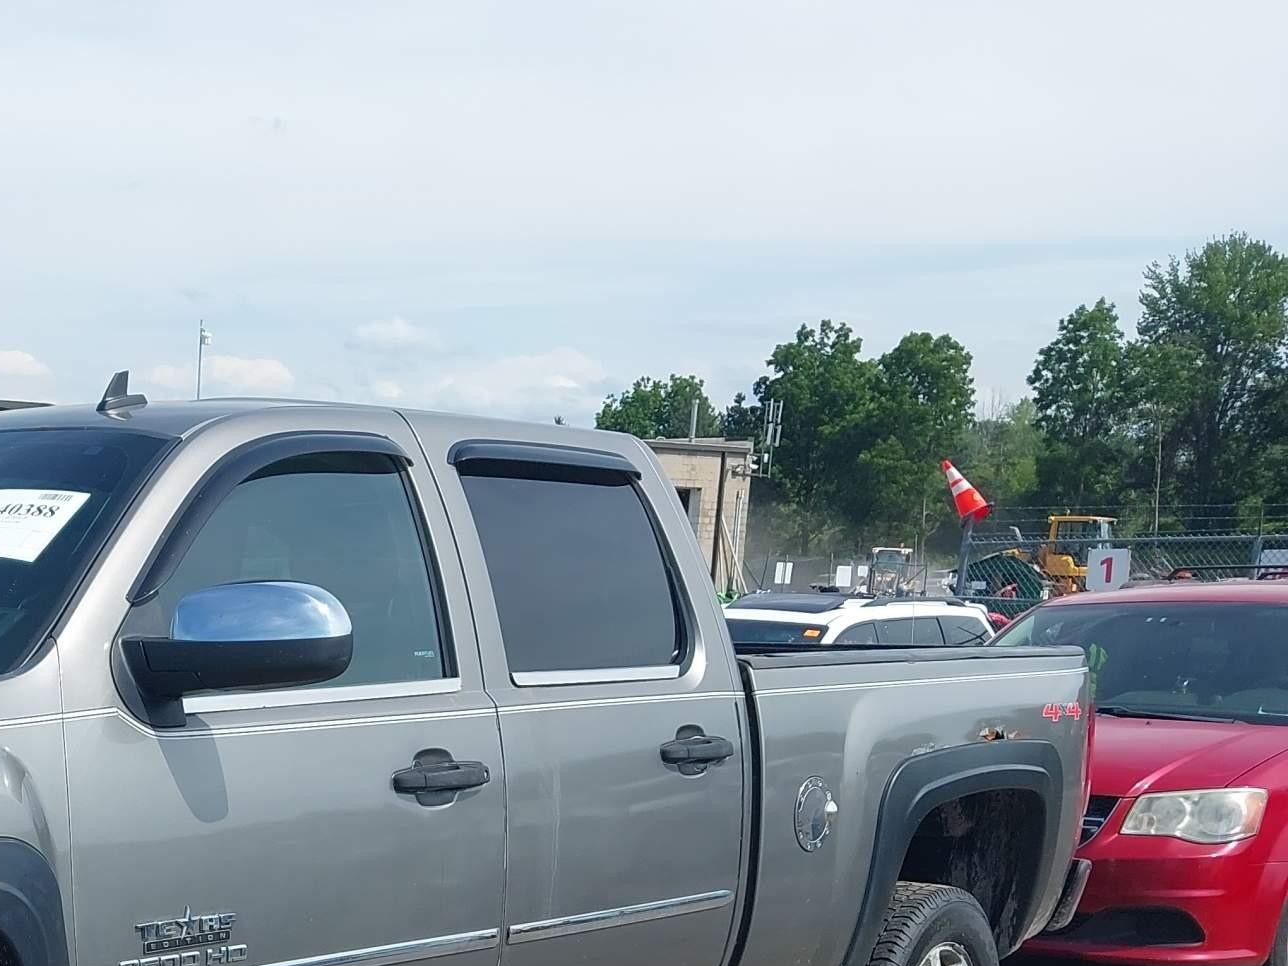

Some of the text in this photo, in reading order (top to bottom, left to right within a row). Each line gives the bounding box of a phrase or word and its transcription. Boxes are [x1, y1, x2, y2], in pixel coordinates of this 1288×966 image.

[1099, 556, 1113, 583] 1
[135, 905, 237, 941] TEXAS
[149, 931, 227, 951] EDITION
[206, 944, 248, 966] HD
